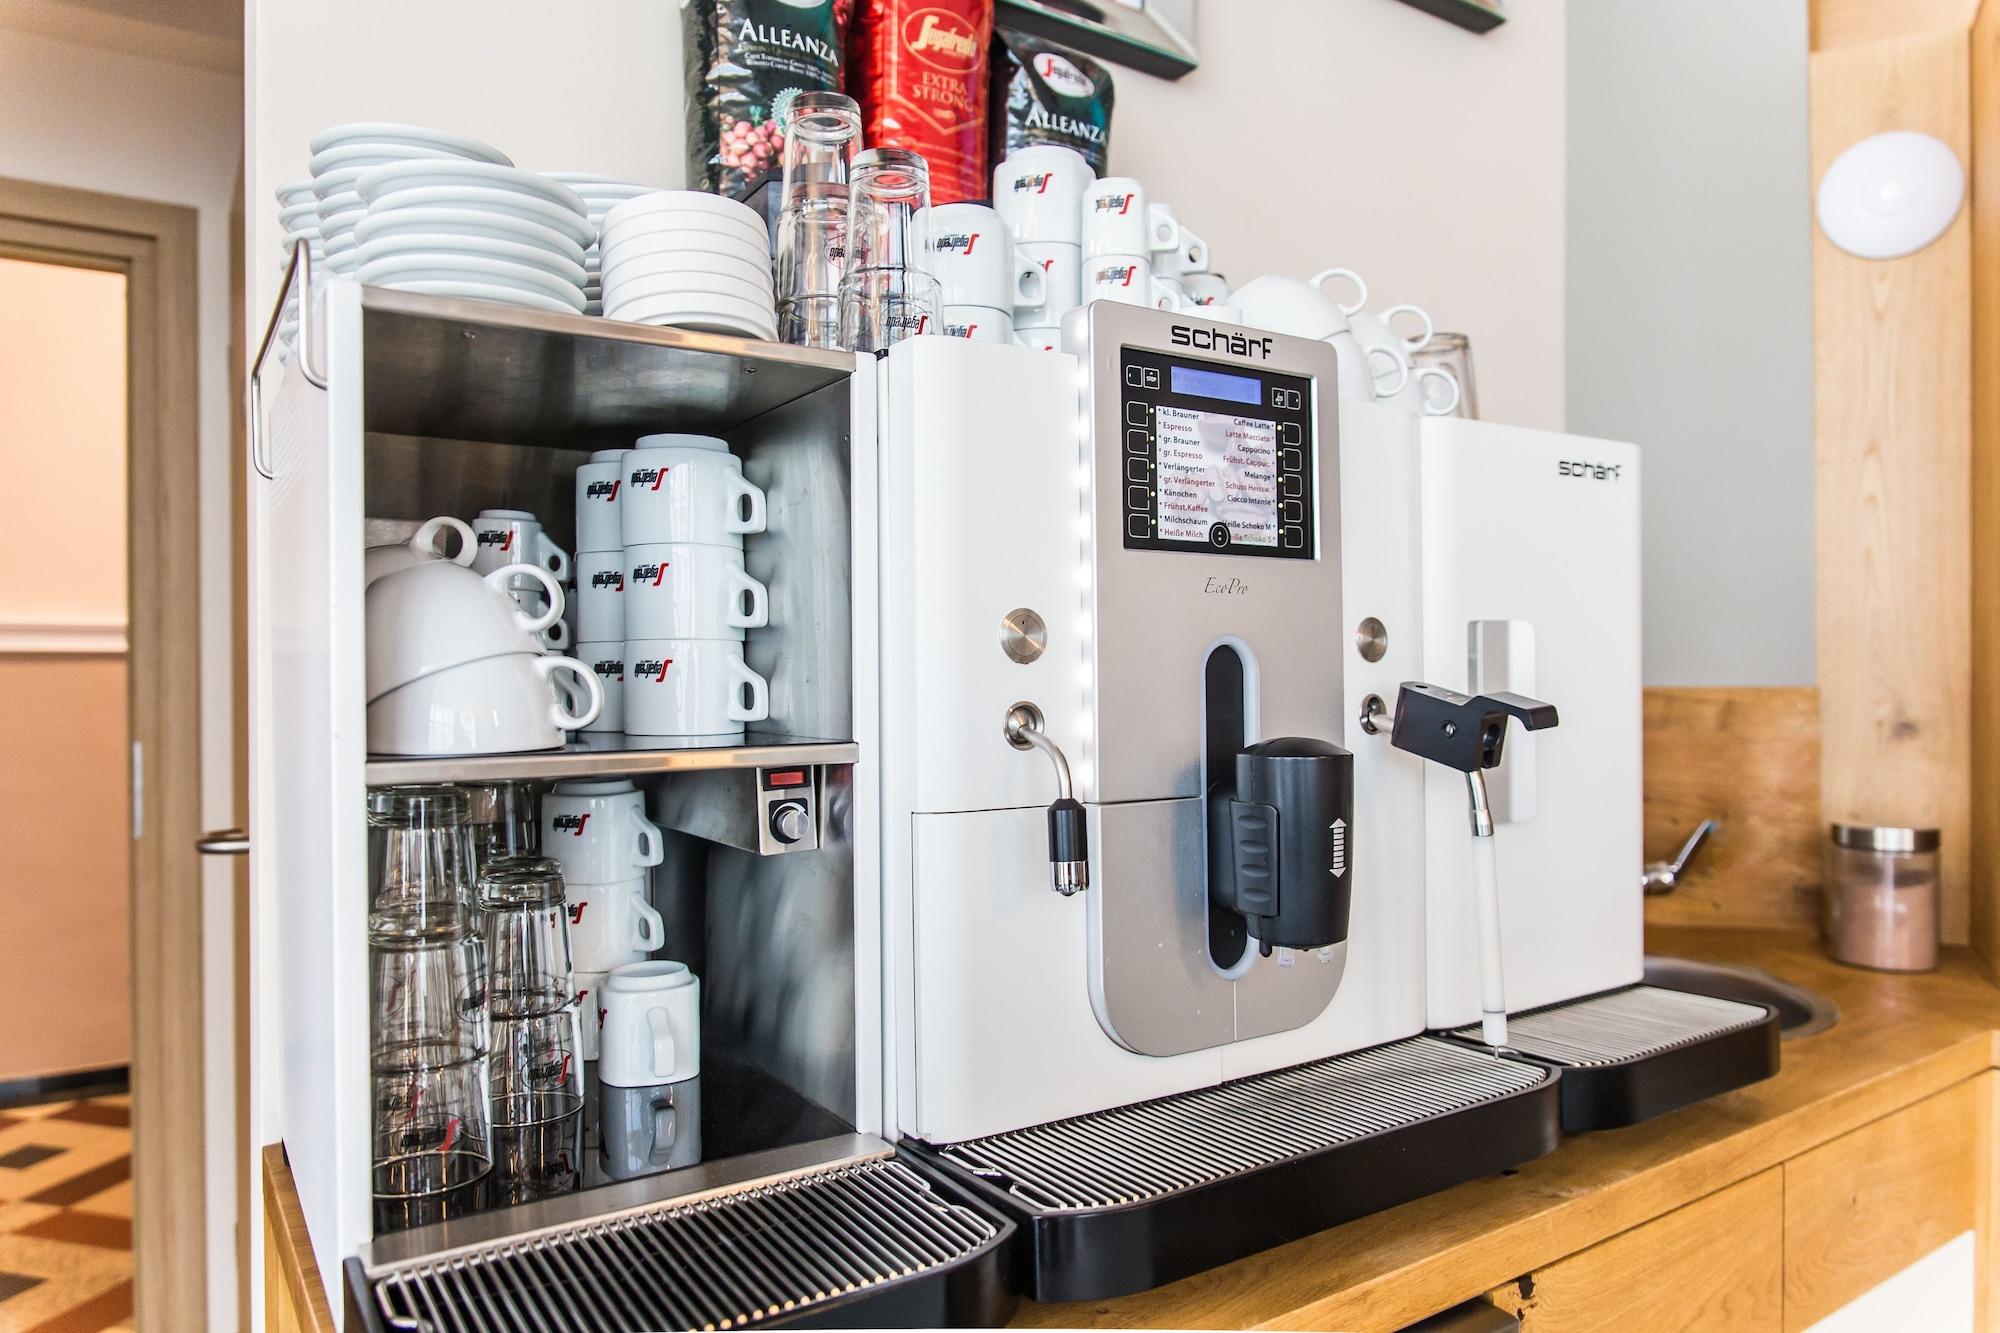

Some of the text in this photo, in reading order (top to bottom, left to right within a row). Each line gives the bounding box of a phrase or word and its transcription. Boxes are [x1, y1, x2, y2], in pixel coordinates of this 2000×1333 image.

[738, 18, 839, 67] ALLEANZA
[922, 71, 968, 95] EXTRA
[912, 84, 975, 113] STRONG
[1171, 325, 1273, 359] schärf
[1162, 408, 1199, 420] kl. Brauner
[1163, 422, 1192, 432] Espresso
[1234, 418, 1270, 430] Caffee Latte
[1163, 436, 1200, 446] gr. Brauner
[1226, 430, 1270, 442] Latte Macciato
[1164, 450, 1202, 460] gr. Espresso
[1238, 444, 1270, 456] Cappucino
[1223, 455, 1270, 468] Frühst. Cappuc.
[1163, 462, 1205, 474] Verlängerter
[1559, 460, 1621, 481] schärf
[1174, 476, 1215, 488] Verlängerter
[1244, 471, 1271, 482] Melange
[1164, 488, 1198, 498] Kännchen
[1248, 496, 1272, 506] Intense
[1164, 515, 1208, 526] Milchschaum
[1242, 521, 1264, 530] Schoko
[1164, 529, 1204, 538] Heiße Milch
[1204, 576, 1249, 594] EcoPro
